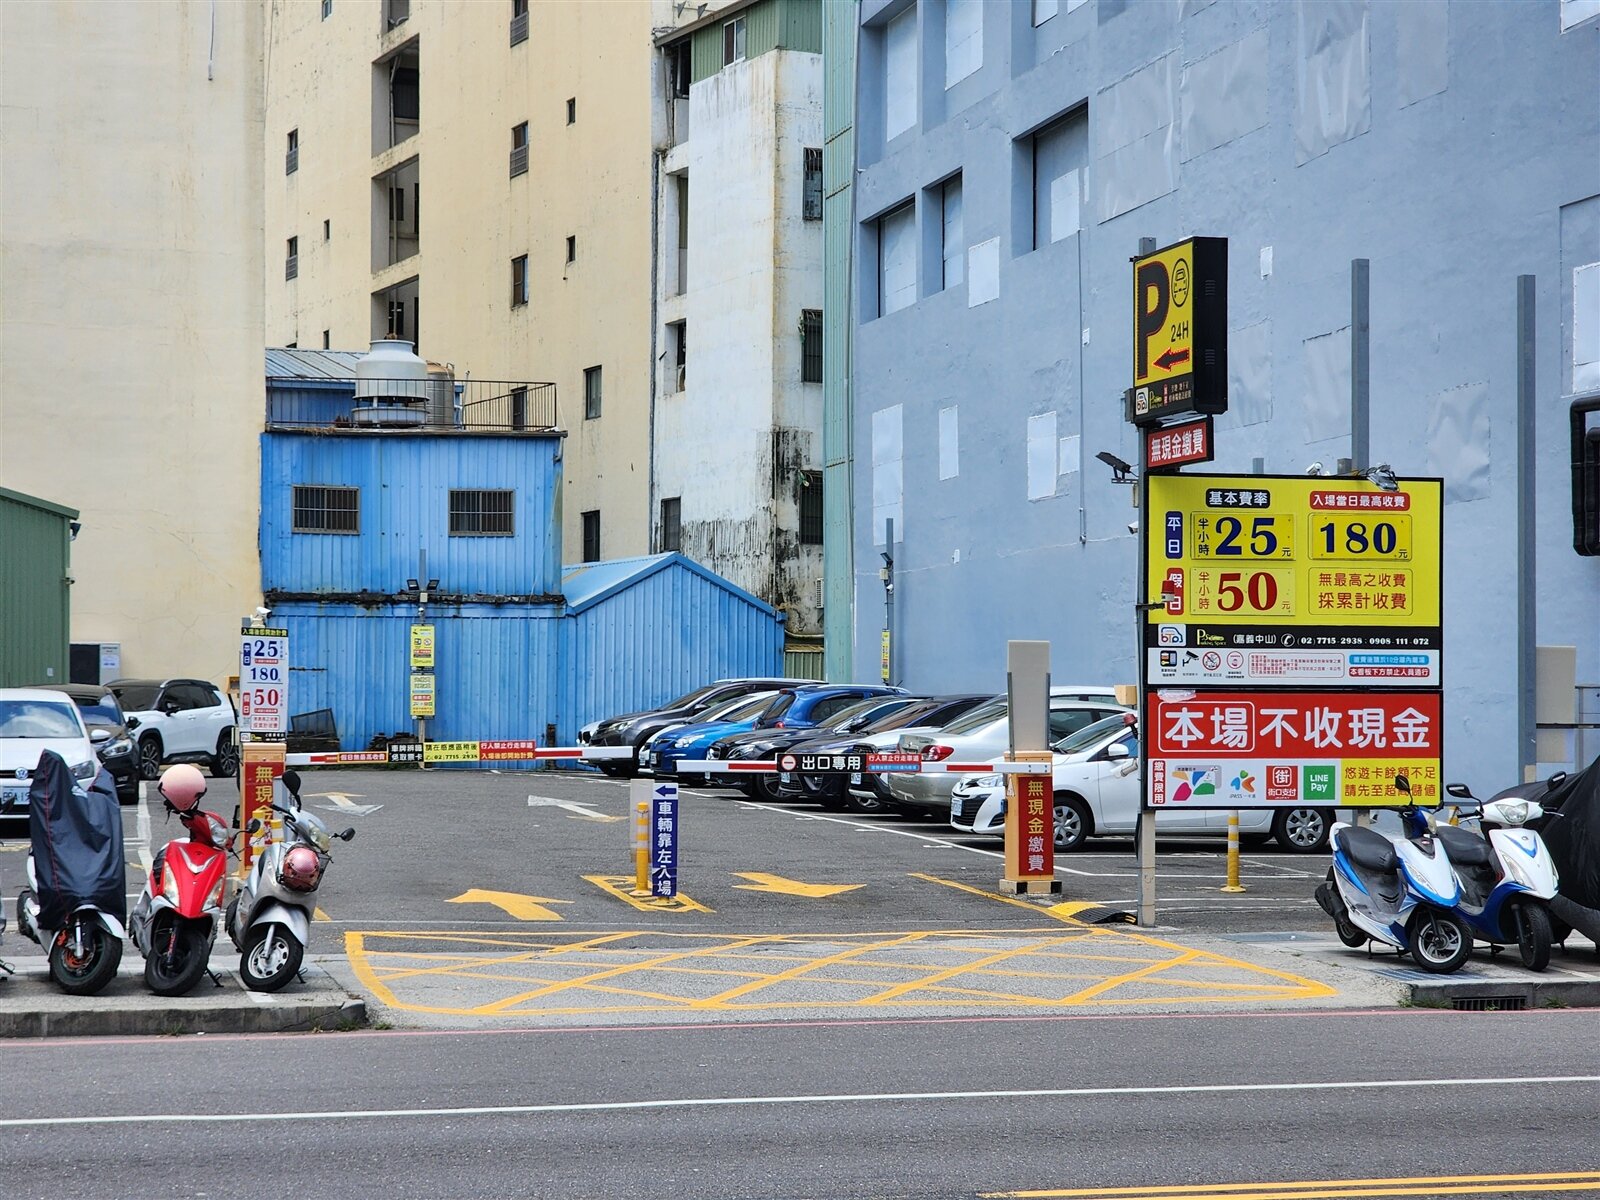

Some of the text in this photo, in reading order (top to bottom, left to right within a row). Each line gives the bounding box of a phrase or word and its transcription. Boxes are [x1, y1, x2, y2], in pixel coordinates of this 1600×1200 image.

[1137, 260, 1170, 380] P
[1171, 320, 1189, 342] 24H
[1151, 428, 1204, 462] 無現金繳費
[1208, 490, 1268, 506] 基本費率
[1313, 494, 1405, 508] 入場當日最高收費
[1167, 516, 1182, 553] 平日
[1198, 516, 1291, 557] 半小時 25 元
[1320, 522, 1408, 558] 180 元
[1318, 572, 1406, 588] 無最高之收費
[1198, 571, 1291, 612] 半小時 50 元
[1318, 592, 1406, 610] 採累計收費
[254, 640, 278, 658] 25
[250, 667, 279, 681] 180
[254, 689, 279, 706] 50
[802, 755, 861, 770] 出口專用
[1154, 761, 1165, 804] 繳費限用
[1310, 774, 1329, 782] LINE
[1267, 788, 1296, 797] 街口支付
[1311, 783, 1328, 793] Pay
[1028, 780, 1044, 872] 無現金繳費
[657, 801, 673, 896] 車輛靠左入場
